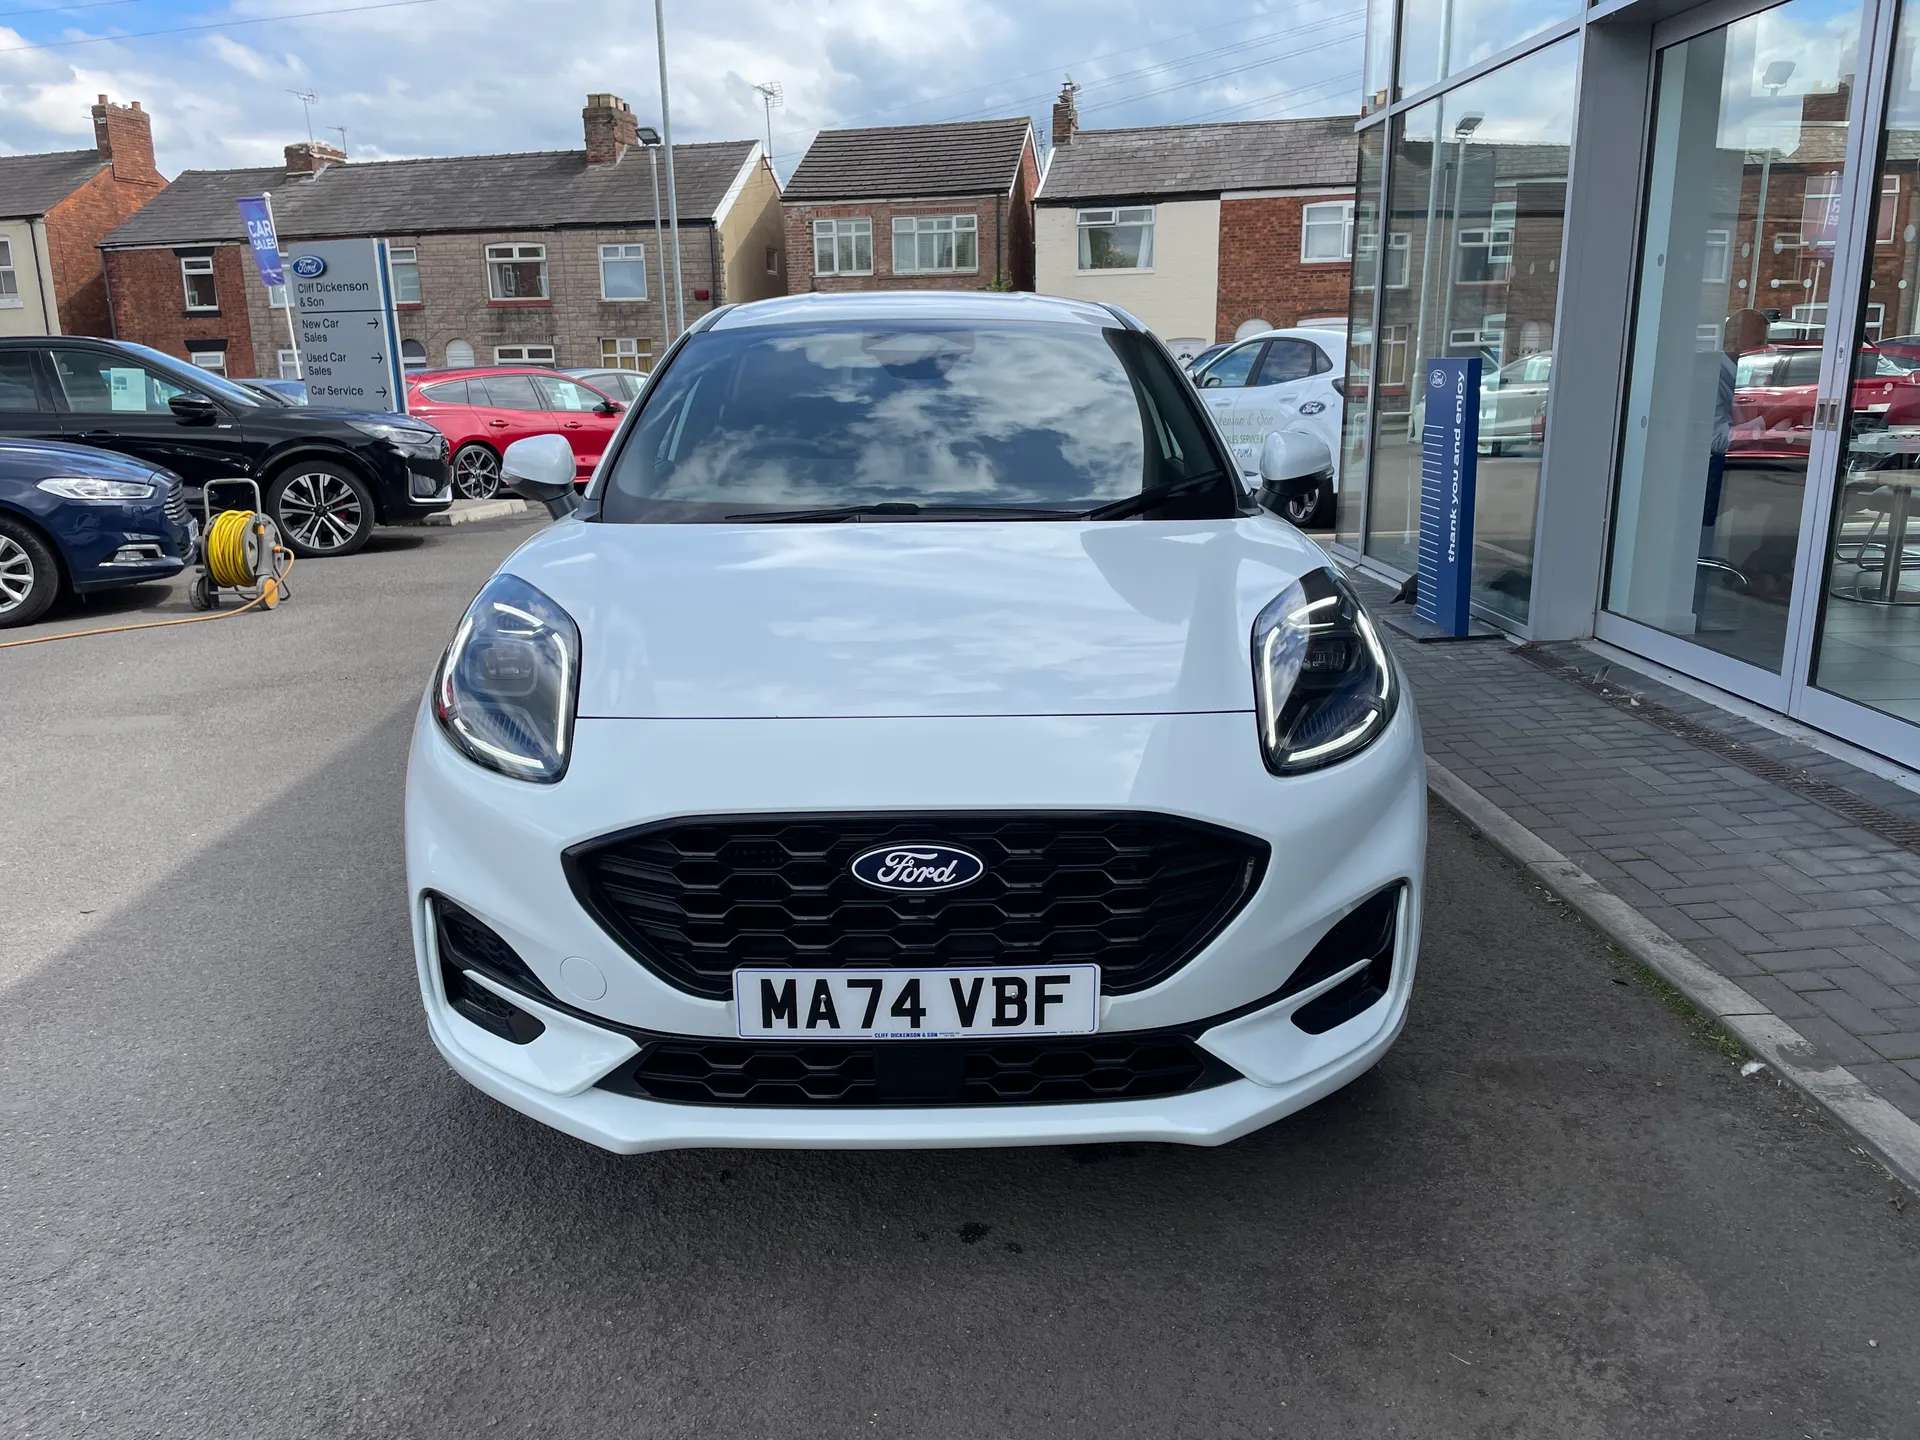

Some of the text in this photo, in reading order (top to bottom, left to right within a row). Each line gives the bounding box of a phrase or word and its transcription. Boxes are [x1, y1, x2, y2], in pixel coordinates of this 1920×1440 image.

[247, 220, 272, 238] CAR
[253, 238, 276, 250] SALES
[297, 258, 319, 274] Ford
[298, 281, 369, 295] Cliff Dickenson
[299, 296, 325, 308] & Son
[302, 318, 339, 330] New Car
[304, 332, 328, 344] Sales
[306, 352, 347, 364] Used Car
[308, 365, 332, 377] Sales
[311, 385, 364, 396] Car Service
[1447, 370, 1465, 564] thank you and enjoy
[877, 851, 958, 883] Ford
[759, 974, 1071, 1030] MA74 VBF
